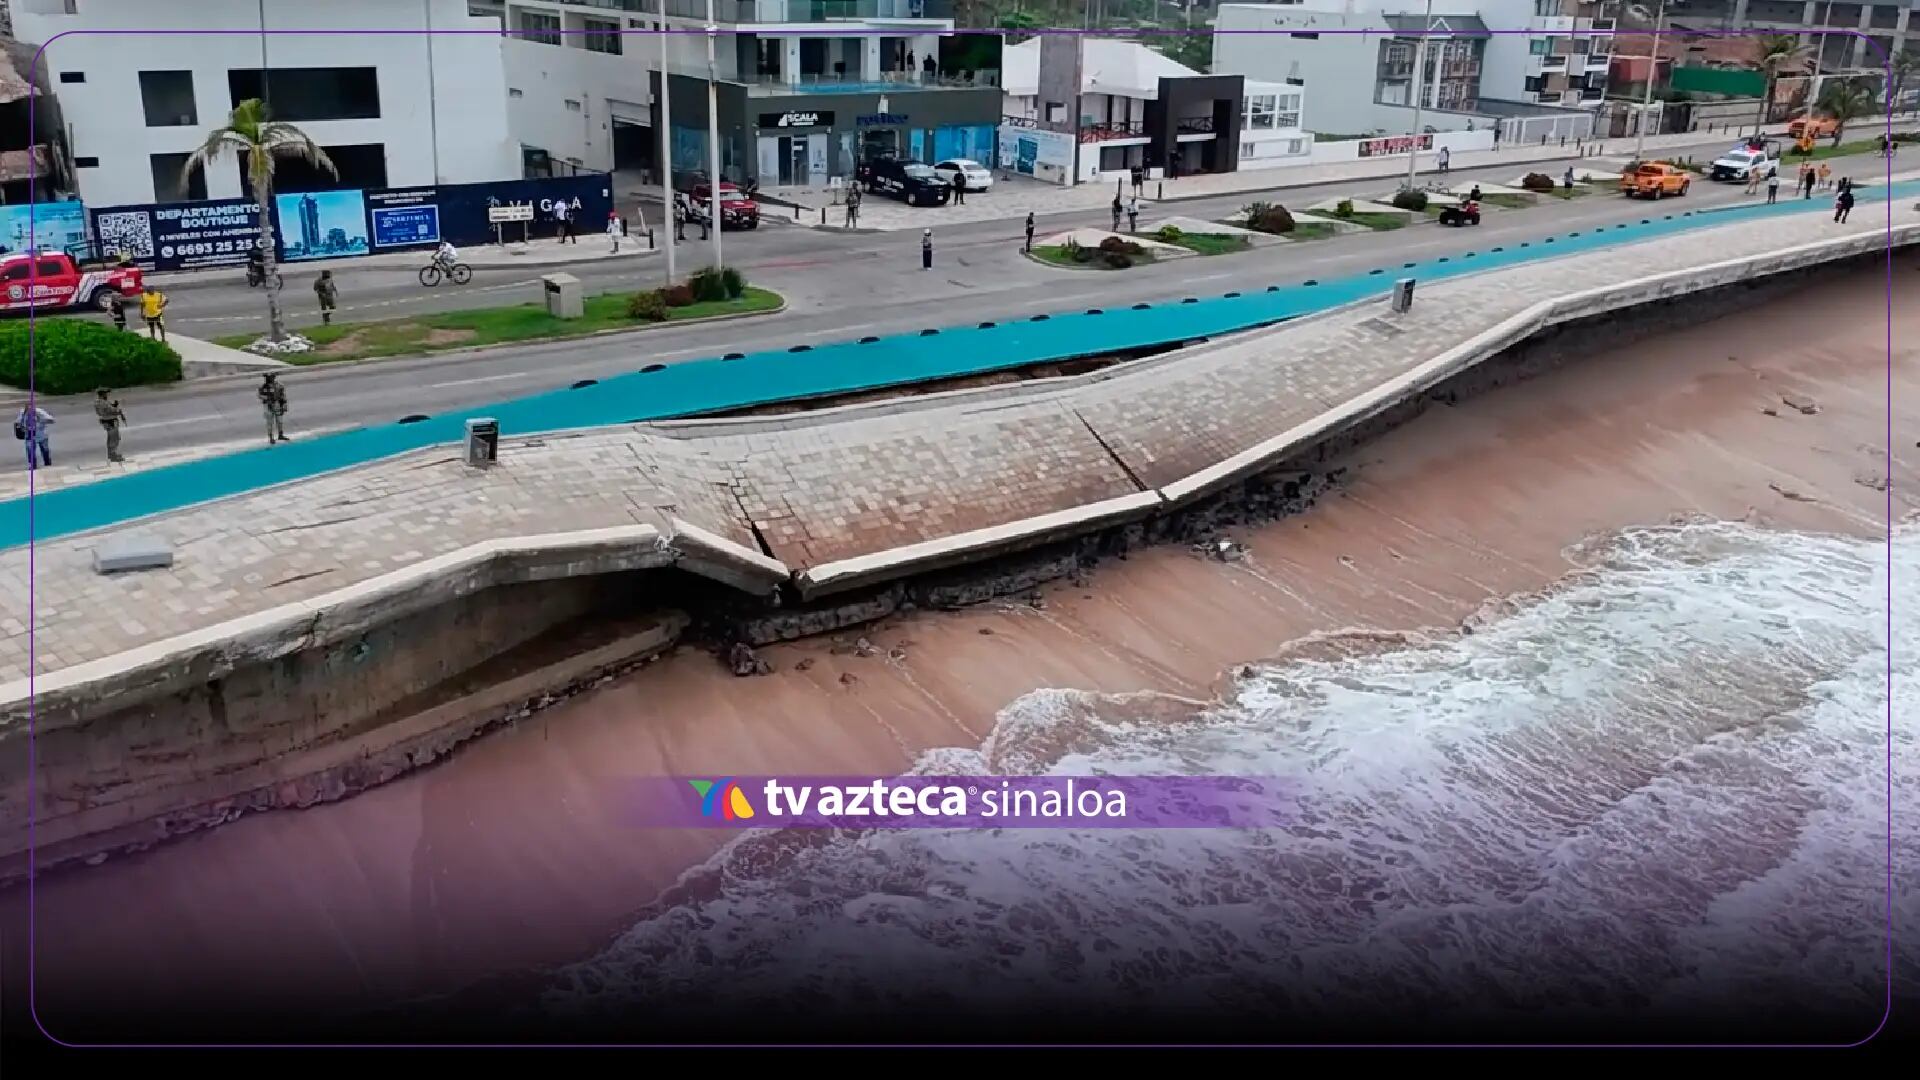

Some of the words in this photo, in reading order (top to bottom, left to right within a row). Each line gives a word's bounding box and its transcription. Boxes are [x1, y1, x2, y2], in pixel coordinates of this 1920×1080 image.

[181, 215, 248, 228] BOUTIQUE
[177, 243, 213, 256] 6693
[216, 242, 233, 252] 25
[236, 239, 252, 251] 25
